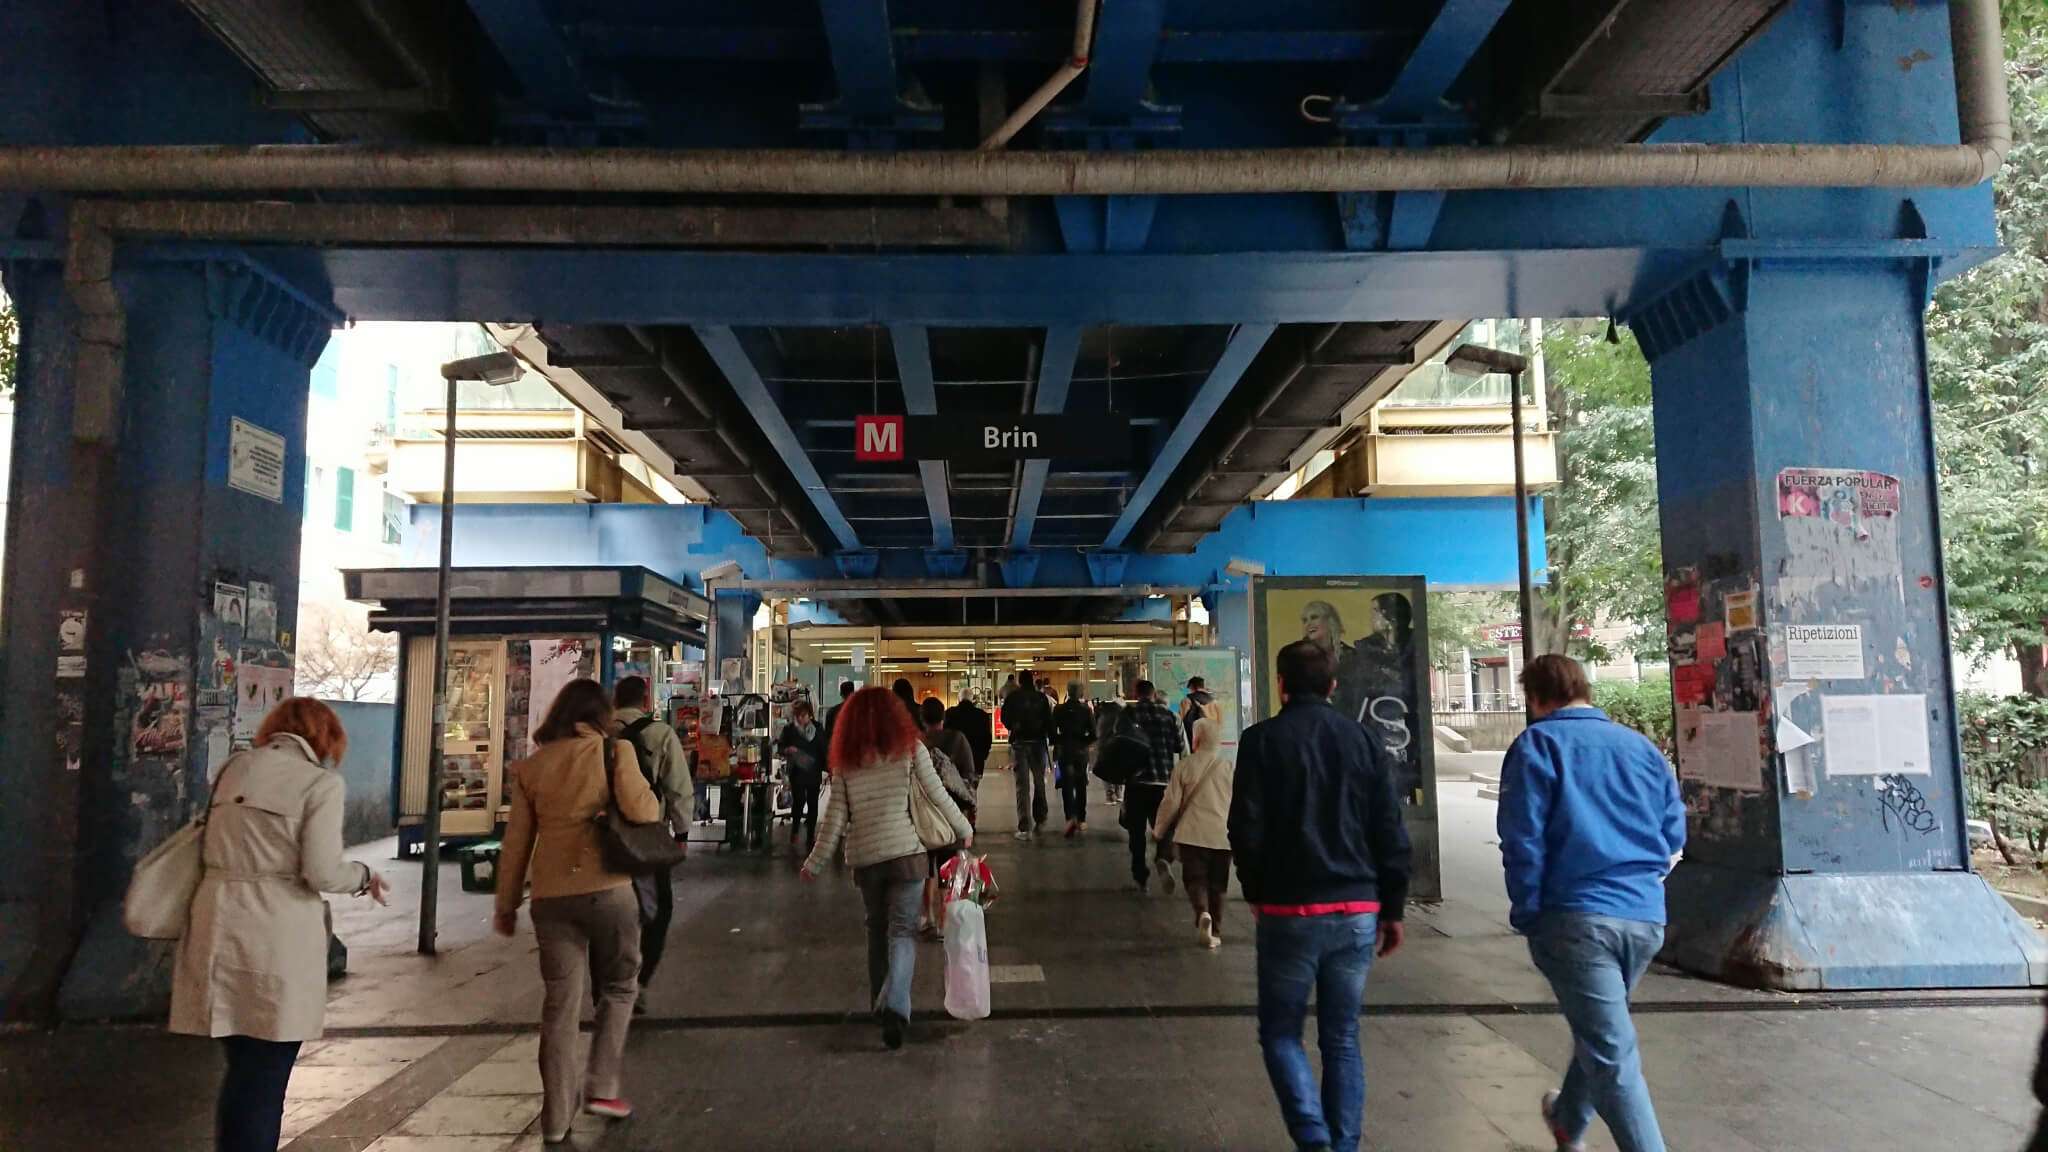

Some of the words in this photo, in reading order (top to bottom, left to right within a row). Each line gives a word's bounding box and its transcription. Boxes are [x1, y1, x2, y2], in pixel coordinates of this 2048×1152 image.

[863, 422, 897, 453] M
[983, 426, 1038, 449] Brin
[1784, 475, 1833, 487] FUERZA
[1836, 476, 1892, 490] POPULAR
[1791, 495, 1806, 513] K
[1787, 626, 1858, 643] Ripetizioni
